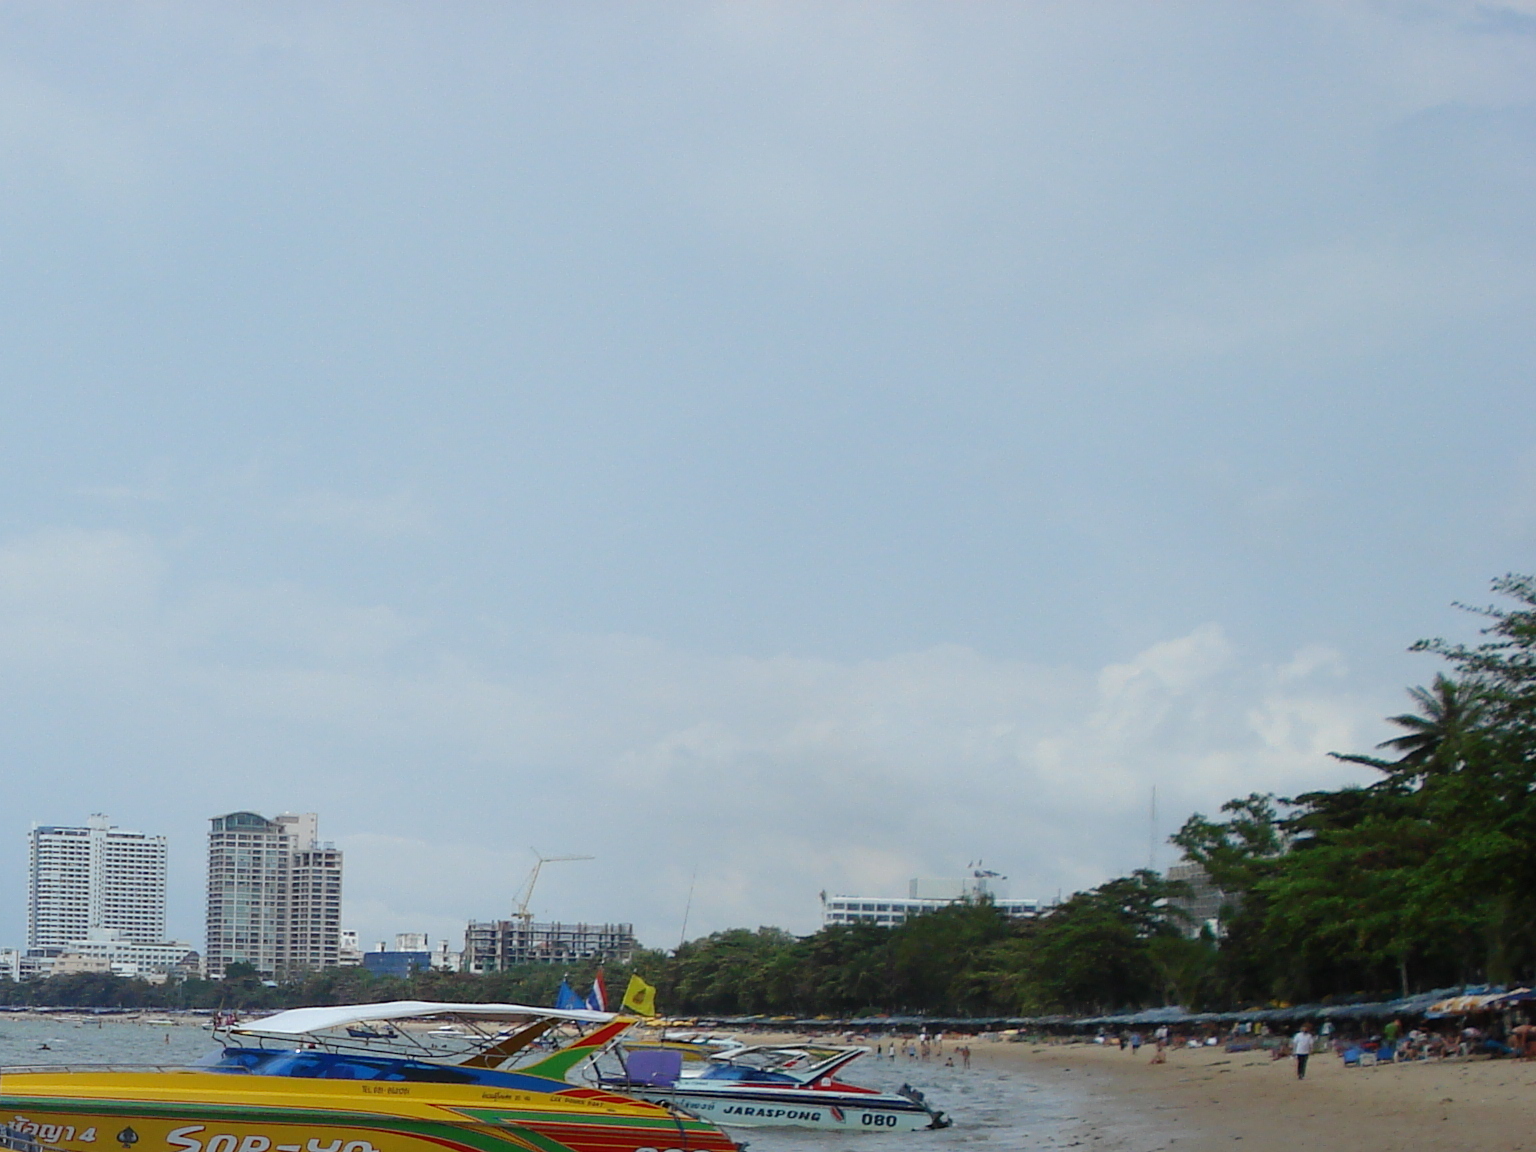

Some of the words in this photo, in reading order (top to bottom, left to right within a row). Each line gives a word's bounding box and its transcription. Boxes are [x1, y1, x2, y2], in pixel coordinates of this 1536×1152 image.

[723, 1105, 822, 1122] JARASPONG
[860, 1112, 898, 1128] 080
[78, 1126, 97, 1142] 4
